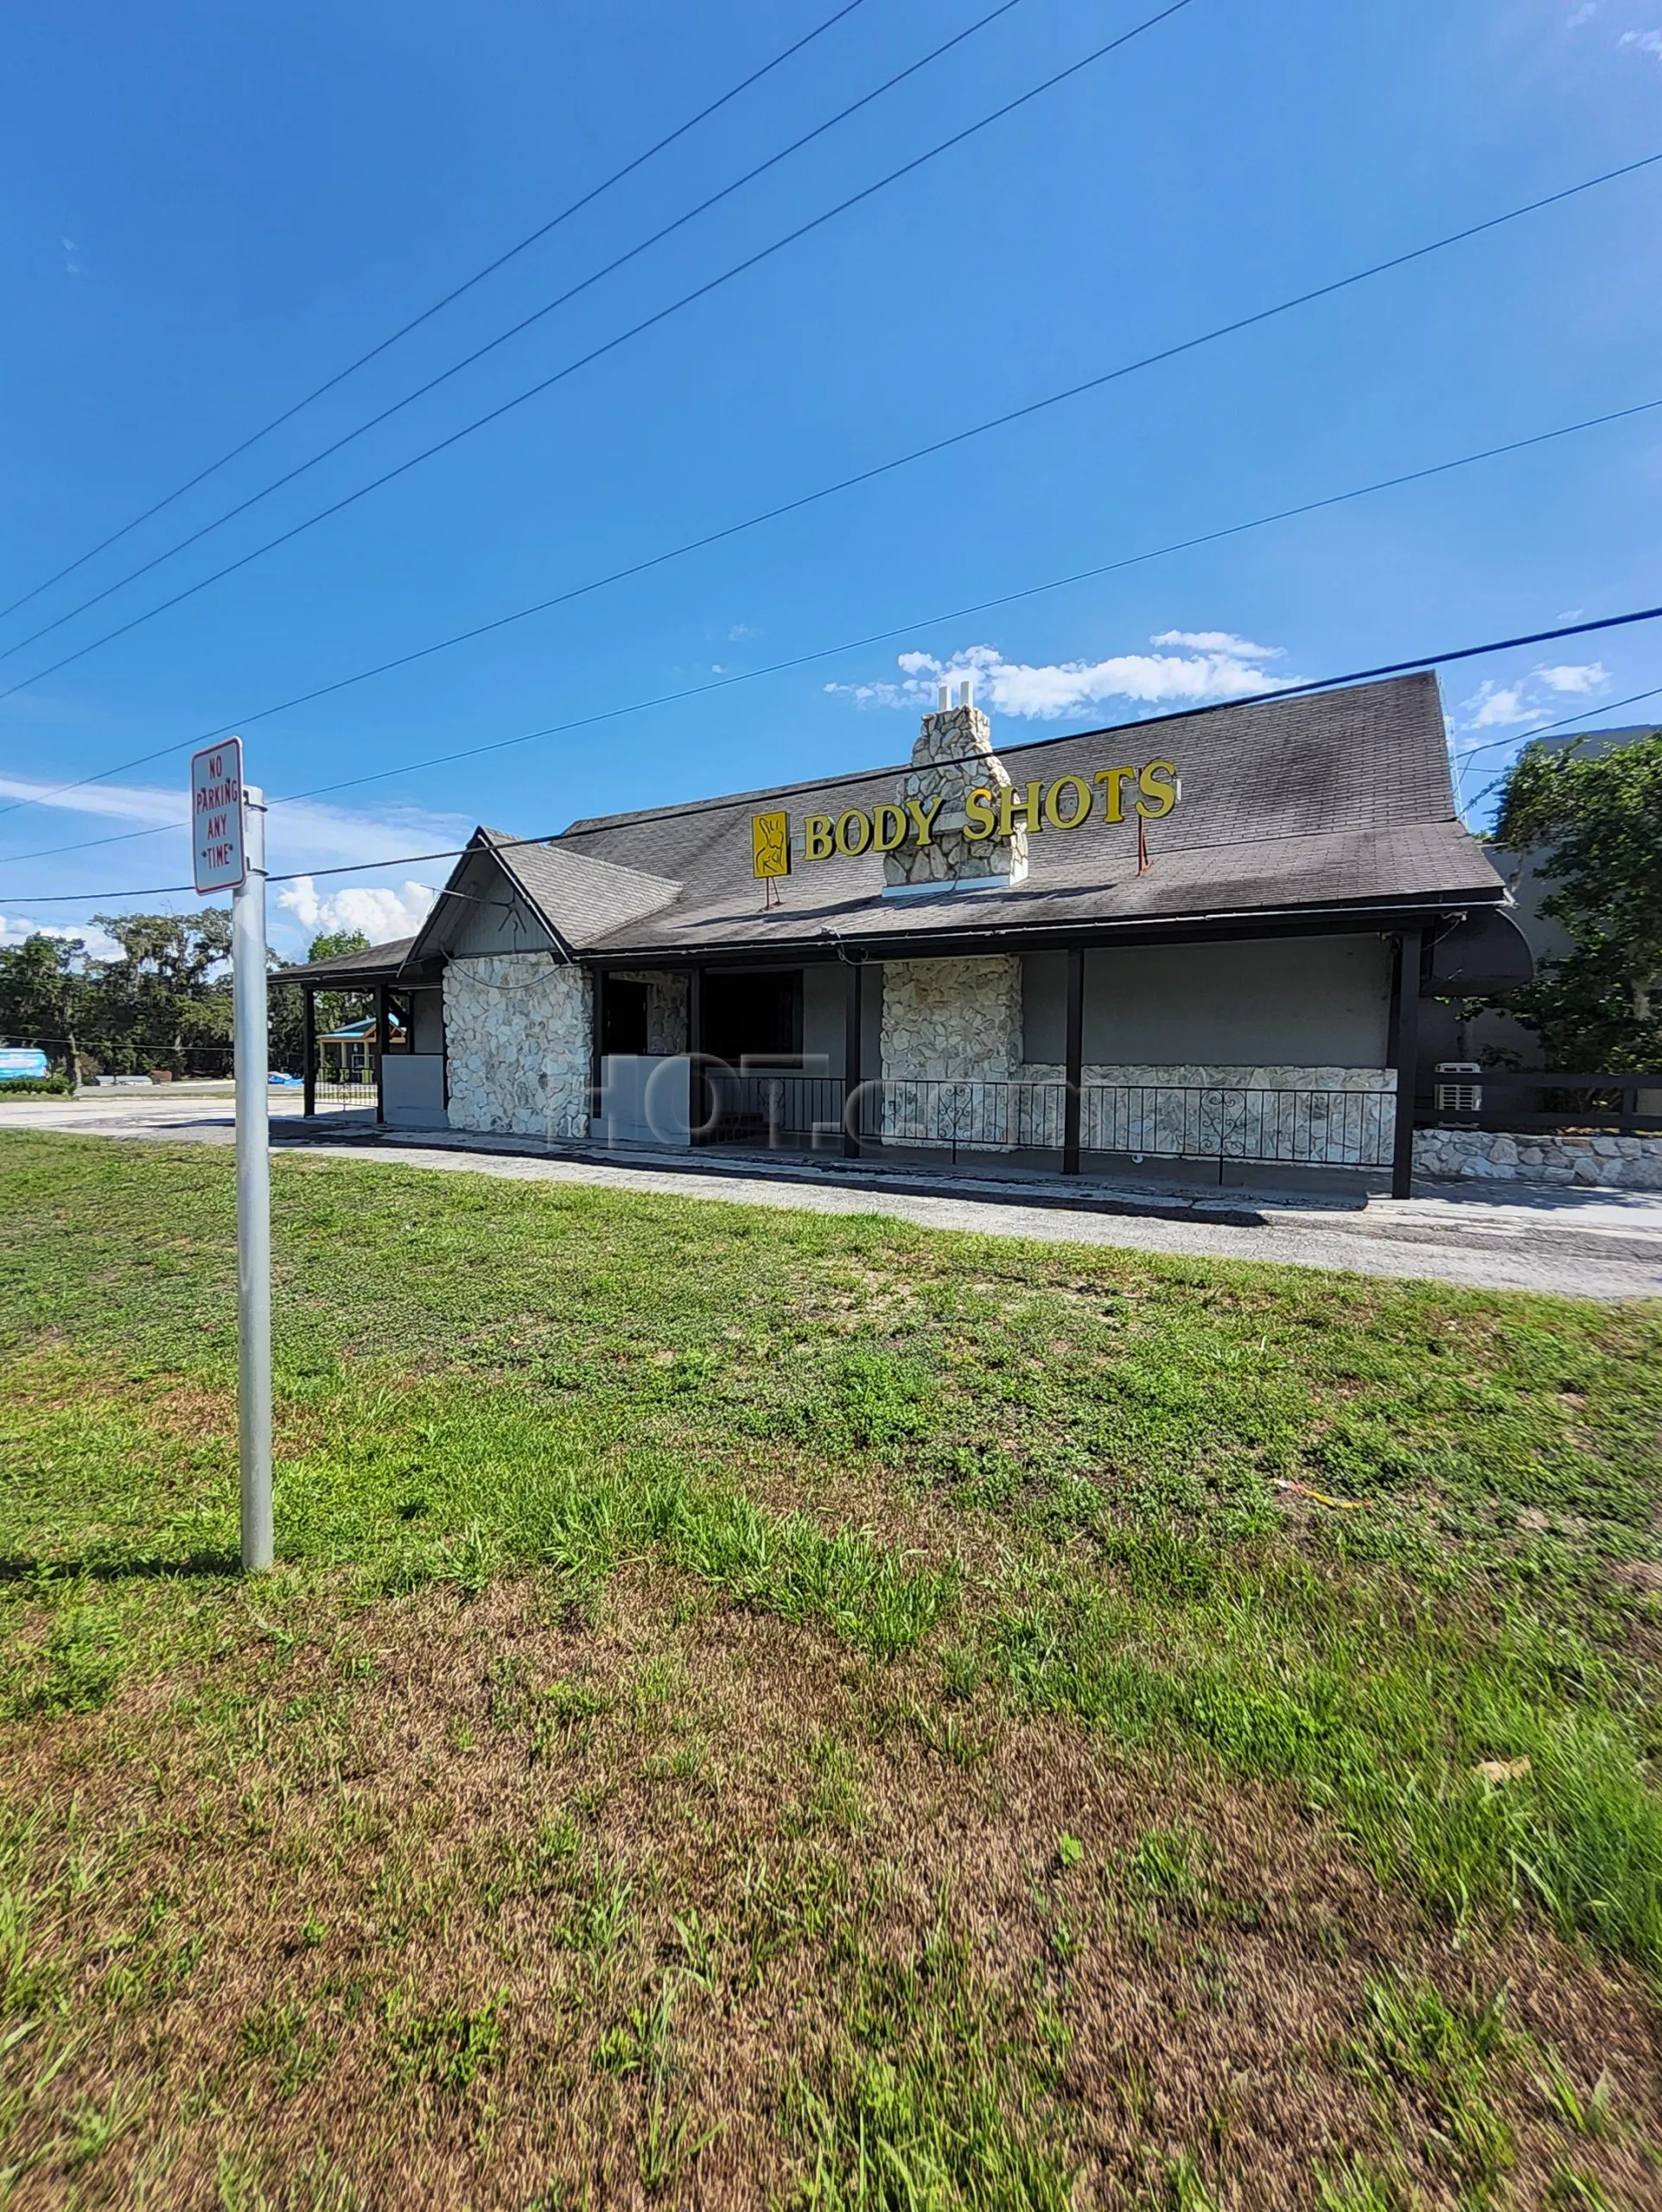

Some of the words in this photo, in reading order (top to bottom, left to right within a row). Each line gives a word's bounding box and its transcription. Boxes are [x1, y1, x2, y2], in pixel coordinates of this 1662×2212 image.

[209, 755, 222, 779] NO
[196, 780, 238, 815] PARKING
[804, 794, 946, 861] BODY
[963, 760, 1179, 841] SHOTS
[207, 813, 227, 840] ANY
[207, 843, 231, 869] TIME
